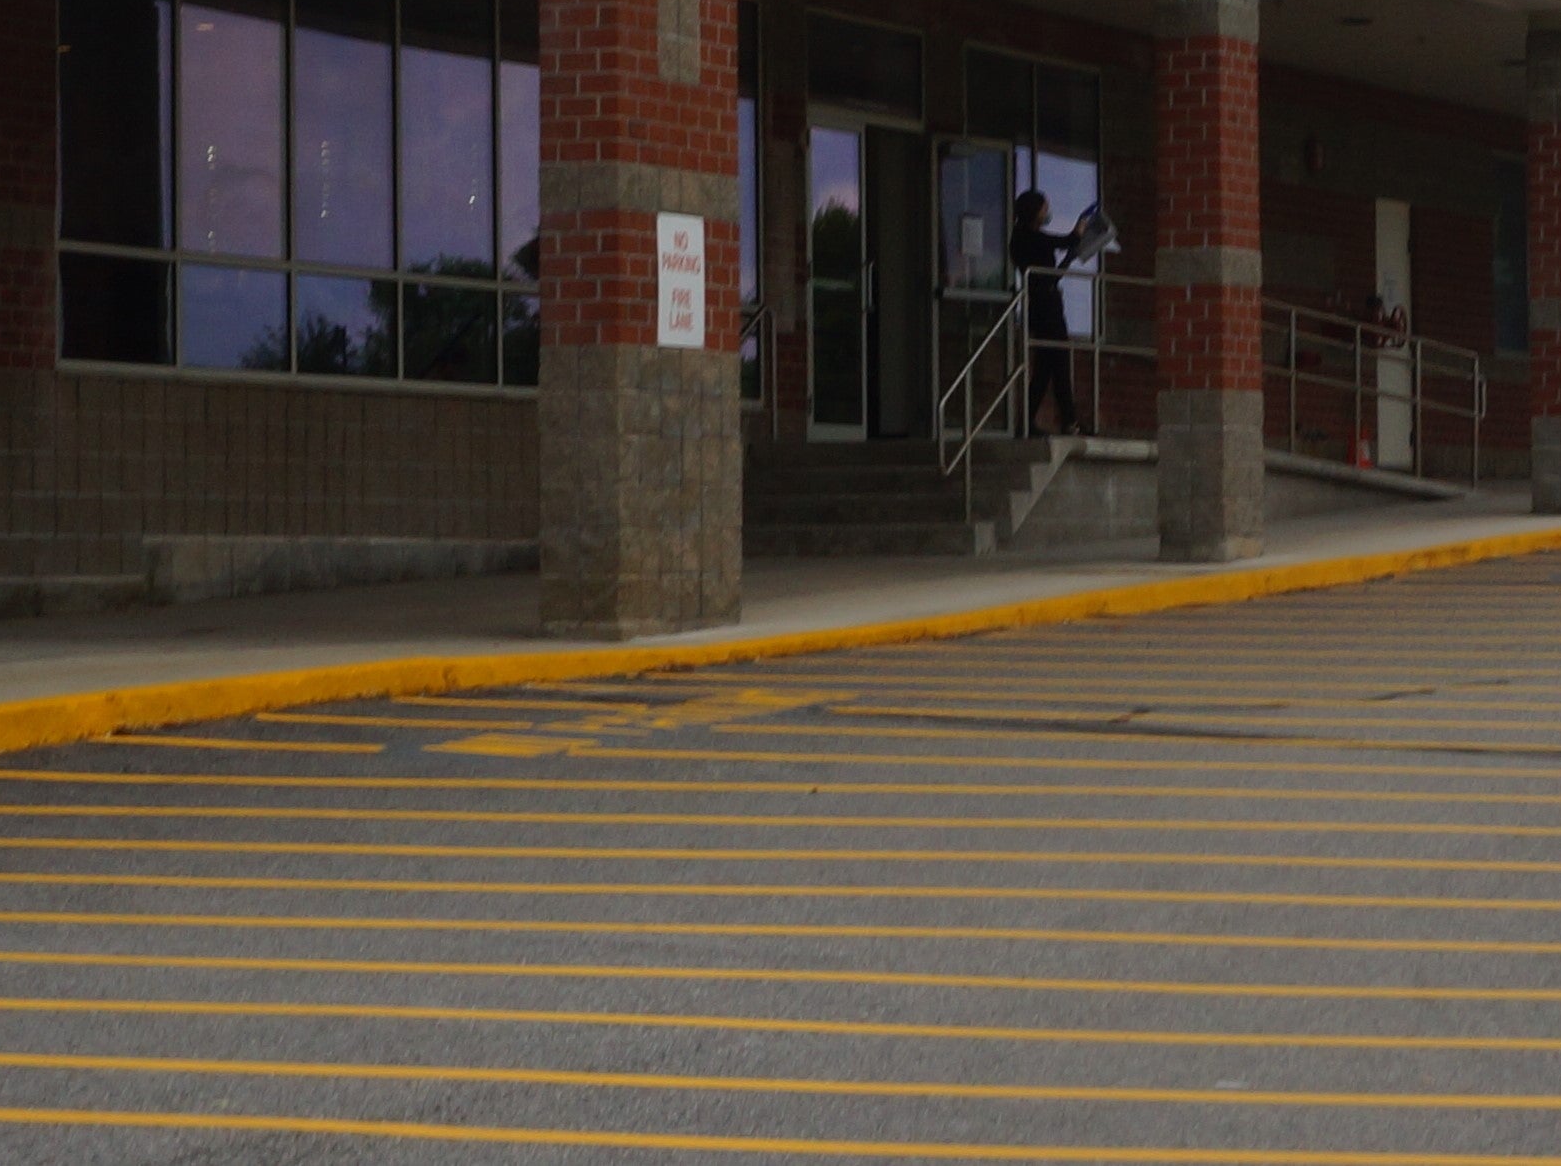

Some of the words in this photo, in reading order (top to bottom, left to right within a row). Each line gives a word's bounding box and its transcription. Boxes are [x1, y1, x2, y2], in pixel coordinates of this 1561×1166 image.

[672, 229, 689, 251] NO
[662, 251, 702, 275] PARKING
[671, 287, 692, 309] FIRE
[669, 311, 694, 332] LANE
